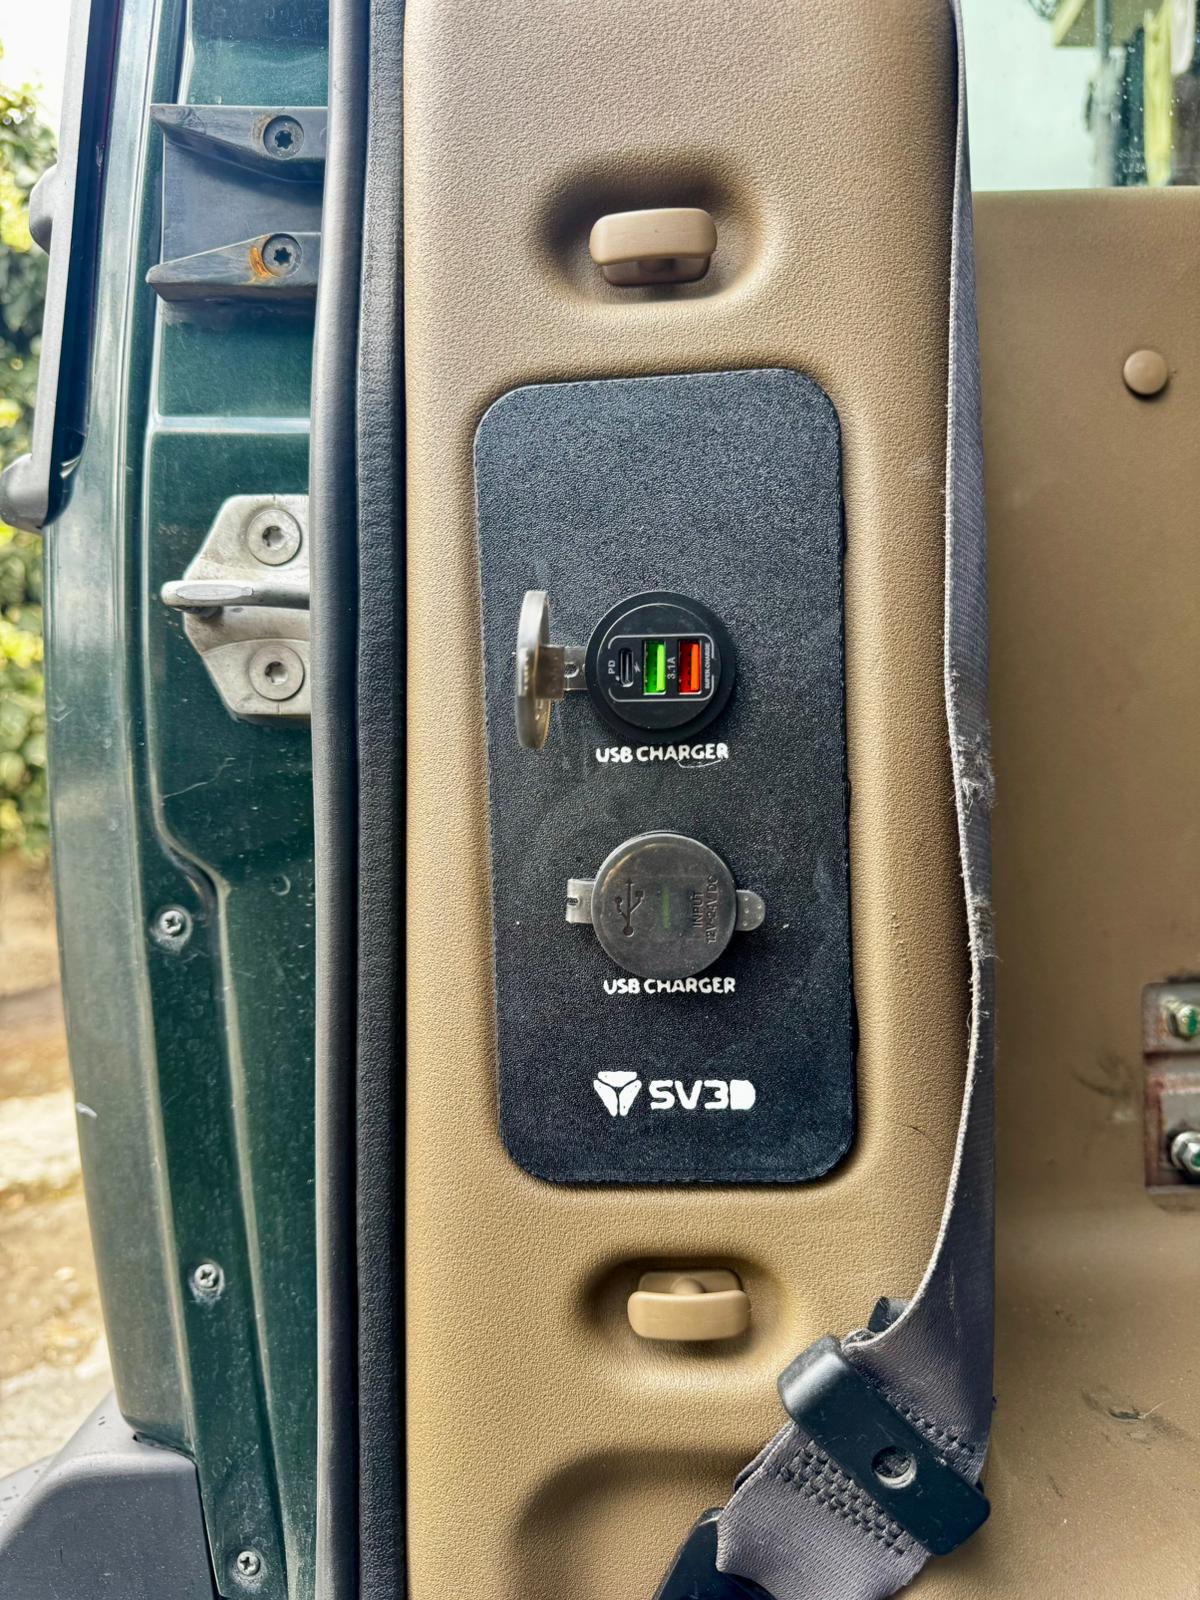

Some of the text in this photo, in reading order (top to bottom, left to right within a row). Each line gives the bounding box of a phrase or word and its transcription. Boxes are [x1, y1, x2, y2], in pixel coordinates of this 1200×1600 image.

[608, 659, 616, 675] PD
[666, 656, 677, 680] 3.1A
[595, 742, 730, 763] USB CHARGER
[692, 891, 704, 928] INPUT
[603, 976, 737, 995] USB CHARGER
[648, 1079, 757, 1111] SV3D
